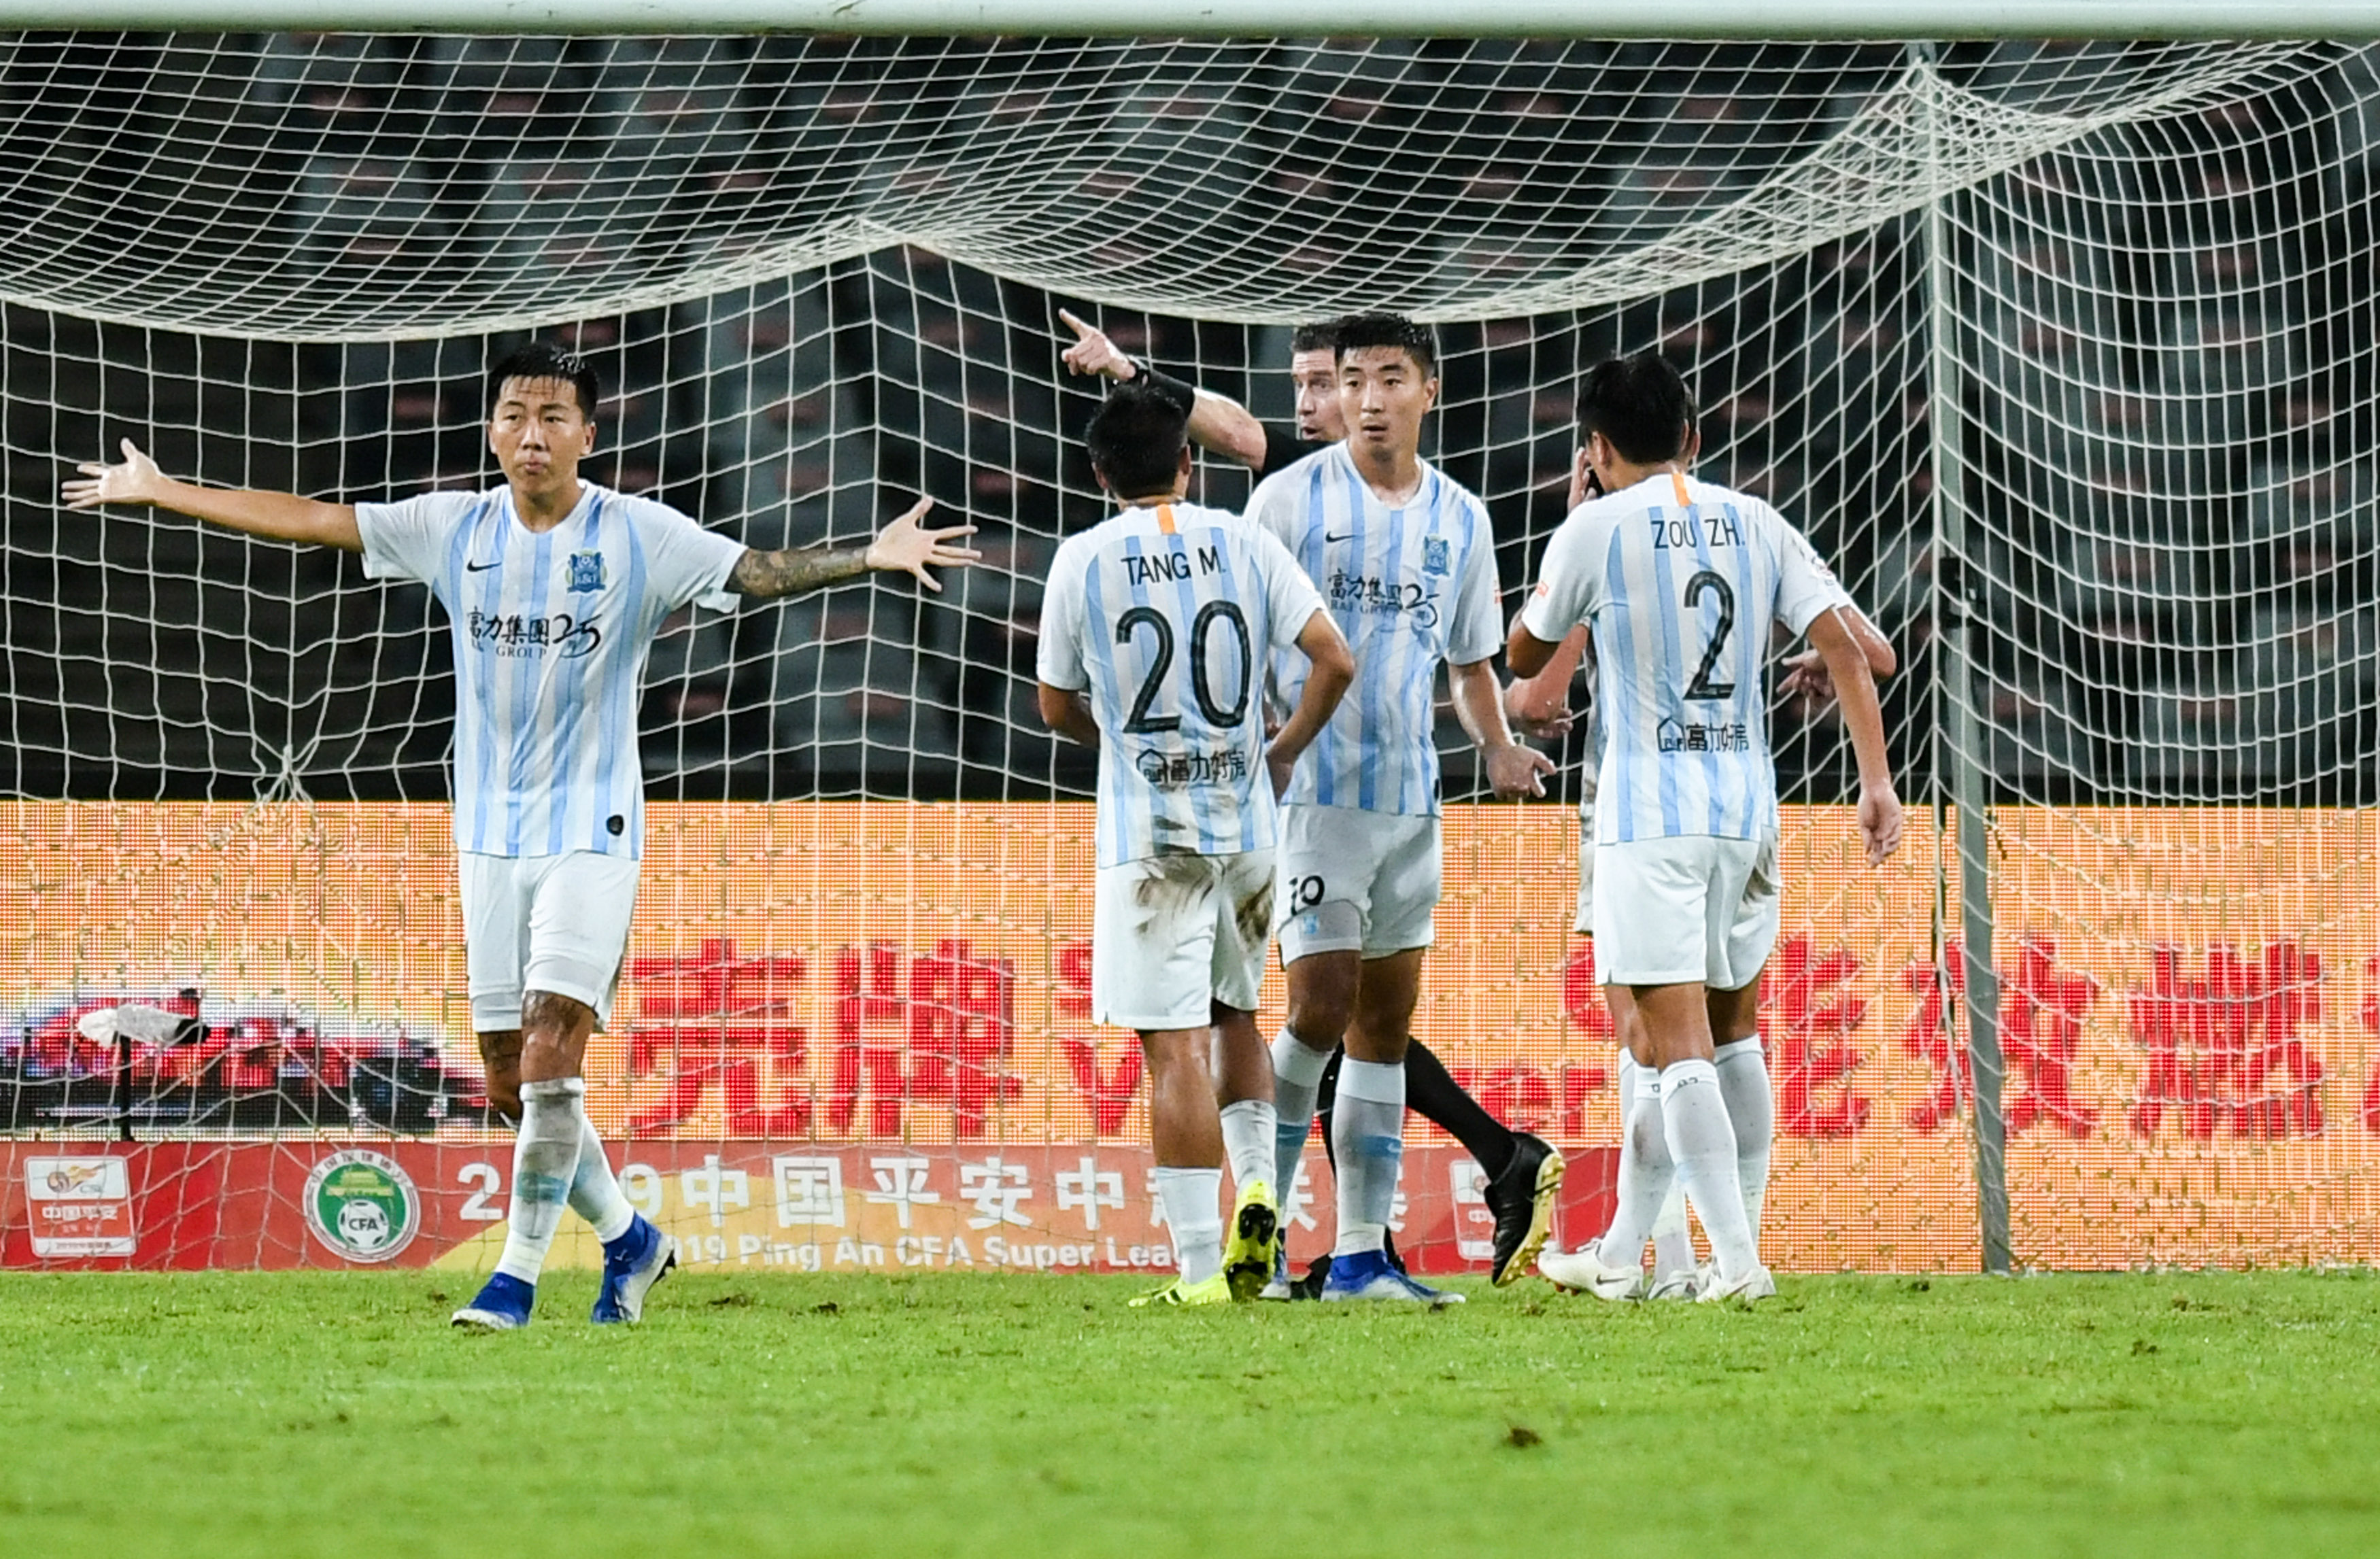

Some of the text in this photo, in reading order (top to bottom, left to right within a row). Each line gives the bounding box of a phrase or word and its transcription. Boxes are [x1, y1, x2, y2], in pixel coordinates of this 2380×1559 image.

[1650, 517, 1746, 549] ZOU ZH.
[1121, 545, 1226, 586] TANG M.
[1684, 570, 1735, 700] 2
[1116, 599, 1251, 734] 20
[630, 938, 1023, 1137] 壳牌
[348, 1218, 379, 1231] CFA
[738, 1234, 821, 1272] Ping
[834, 1236, 884, 1266] An
[896, 1235, 973, 1267] CFA
[983, 1235, 1095, 1270] Super
